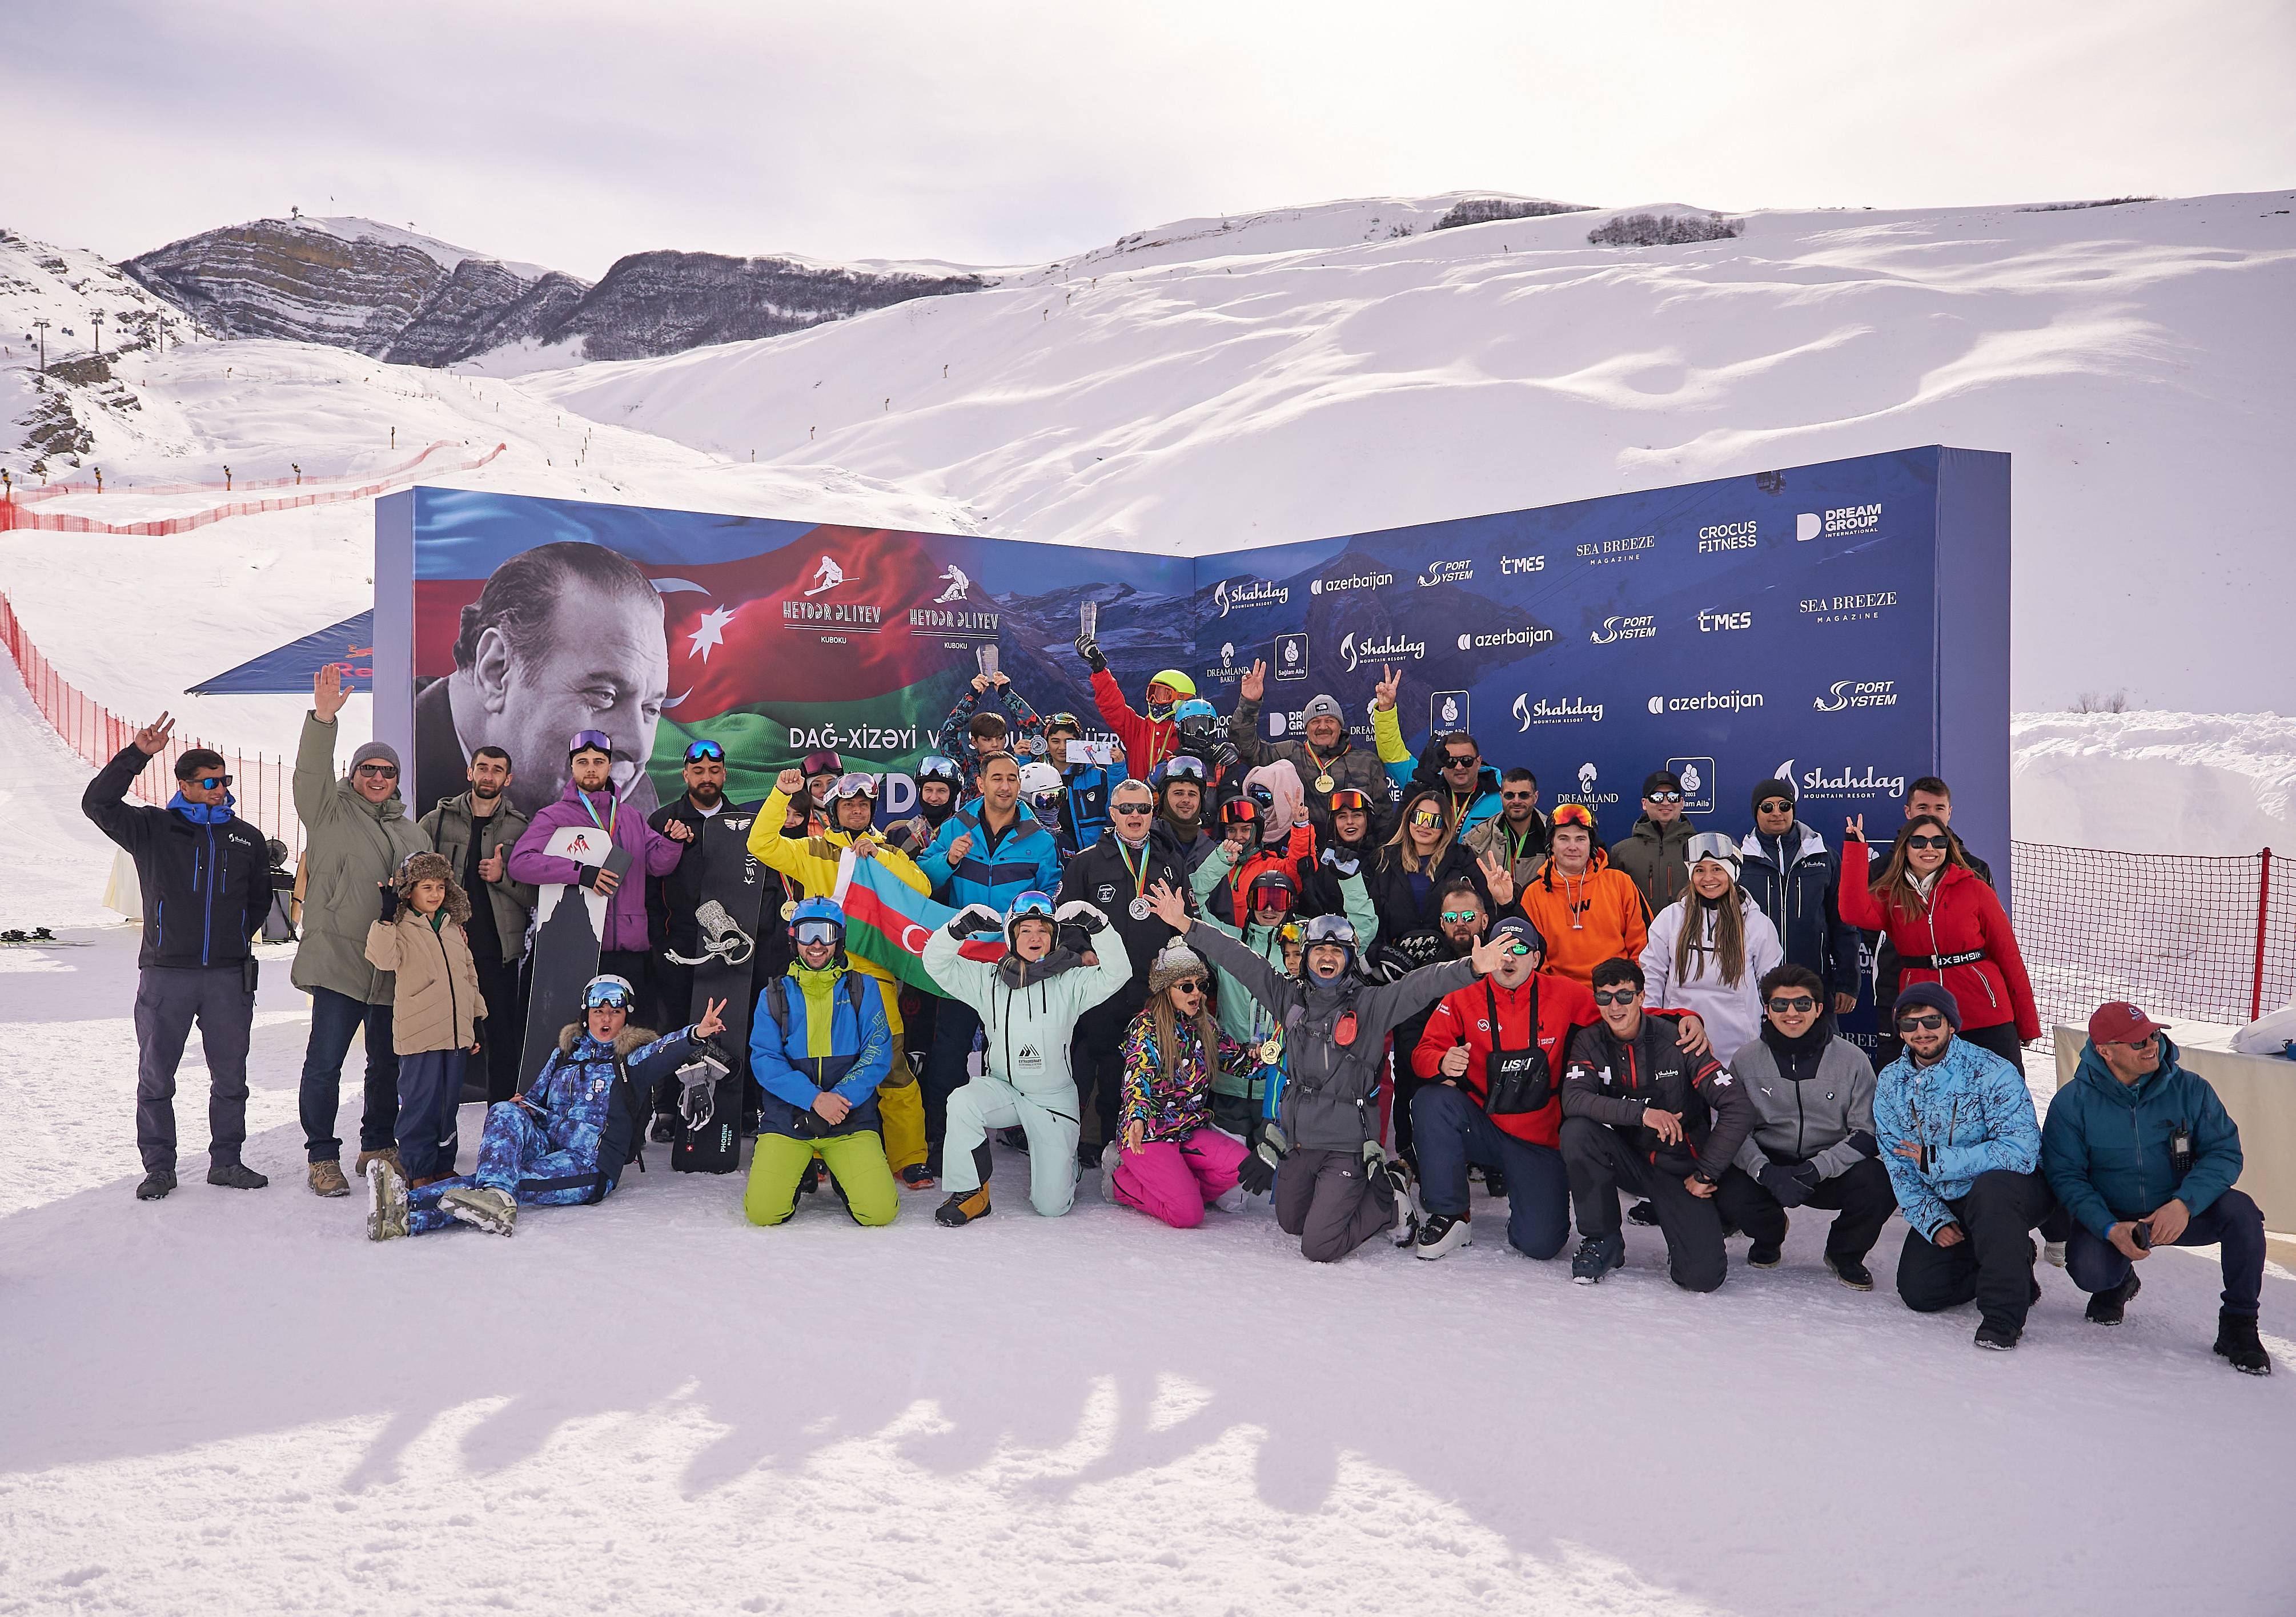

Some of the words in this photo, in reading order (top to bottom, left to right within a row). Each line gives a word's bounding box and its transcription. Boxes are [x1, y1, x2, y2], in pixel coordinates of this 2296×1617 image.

[1825, 504, 1882, 521] DREAM
[1699, 521, 1757, 539] CROCUS
[1825, 516, 1878, 532] GROUP
[1825, 528, 1878, 538] INTERNATIONAL
[1576, 544, 1599, 557] SEA
[1603, 535, 1655, 553] BREEZE
[1699, 534, 1757, 553] FITNESS
[1591, 554, 1640, 565] MAGAZINE
[1326, 571, 1392, 591] azerbaijan
[1231, 581, 1289, 604] Shahdag
[1800, 598, 1828, 613] SEA
[1832, 592, 1897, 610] BREEZE
[1817, 612, 1878, 623] MAGAZINE
[1475, 626, 1553, 647] azerbaijan
[1360, 635, 1425, 659] Shahdag
[1207, 666, 1249, 678] DREAMLAND
[1534, 697, 1603, 721] Shahdag
[1669, 690, 1764, 713] azerbaijan
[790, 723, 917, 749] DAĞ-XİZƏYİ
[928, 730, 940, 749] V
[1803, 766, 1904, 798] Shahdag
[1558, 793, 1619, 803] DREAMLAND
[1382, 945, 1415, 968] BOGNER
[1502, 1057, 1533, 1071] LISKI
[720, 1123, 728, 1152] PHOENIX
